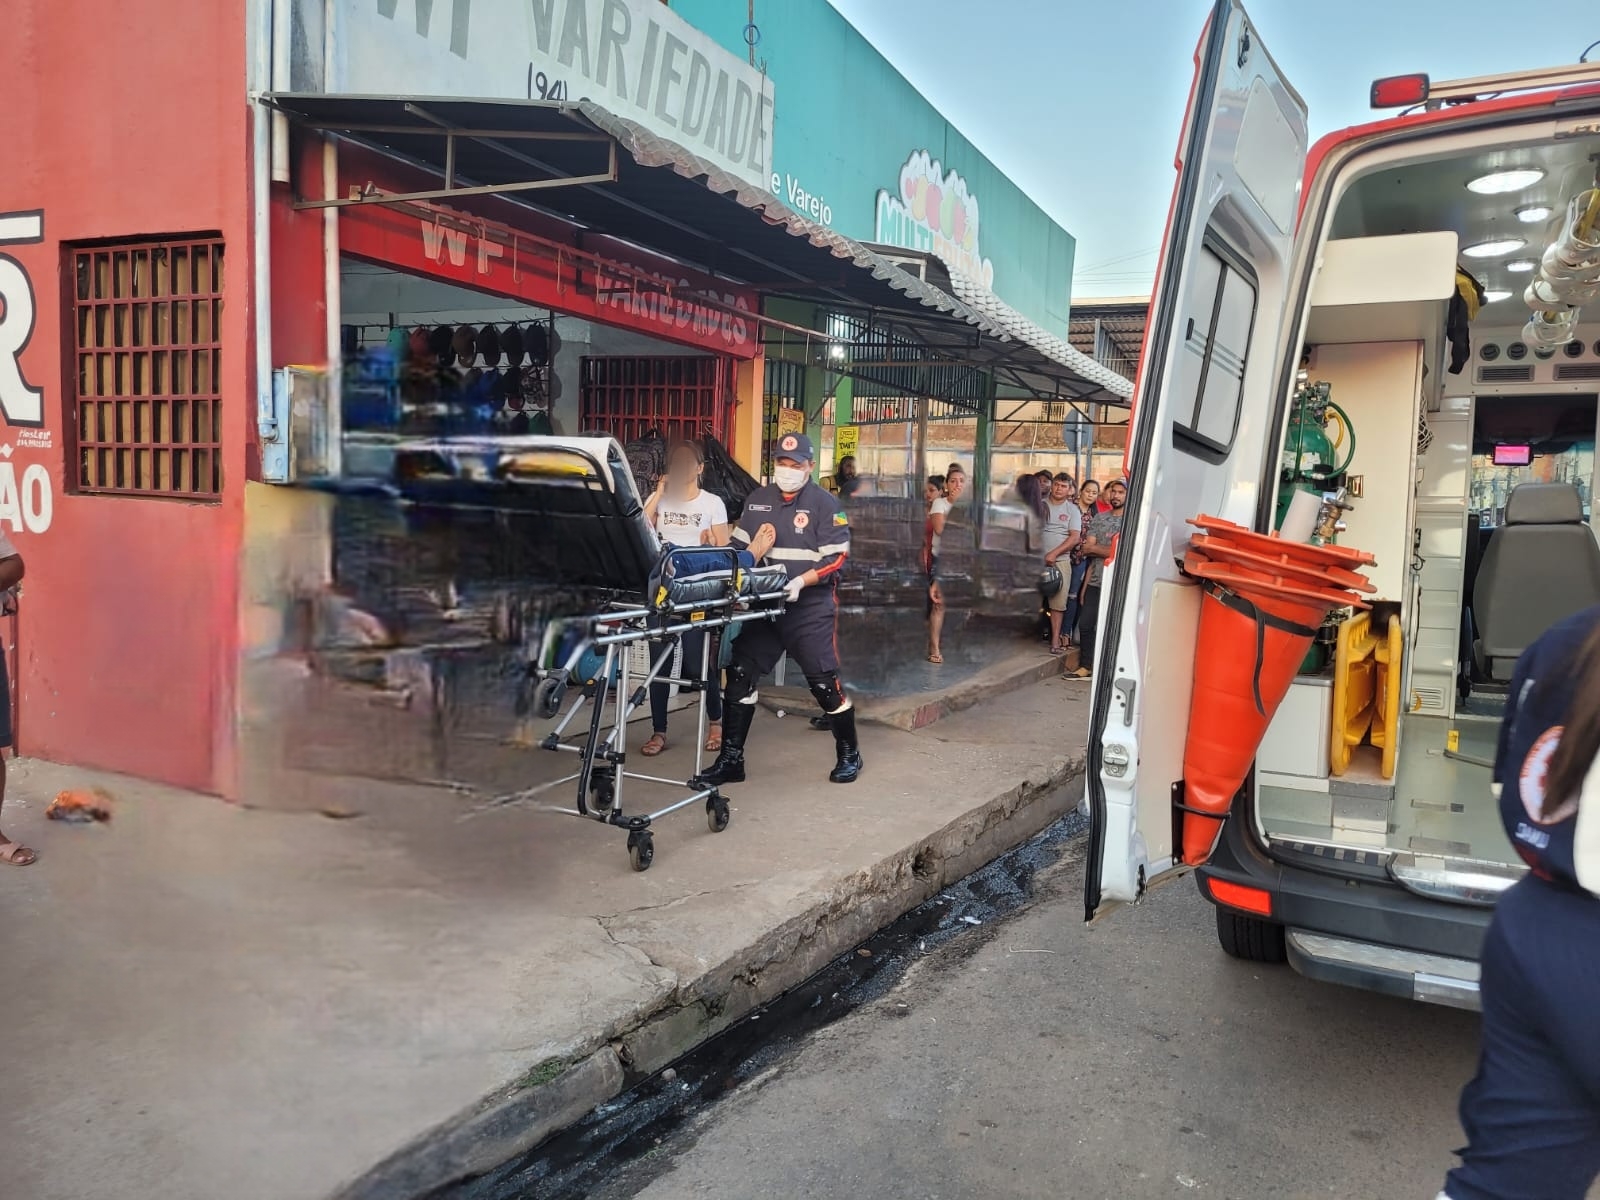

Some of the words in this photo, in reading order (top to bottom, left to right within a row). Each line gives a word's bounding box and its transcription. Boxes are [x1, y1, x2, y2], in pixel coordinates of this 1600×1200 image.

[770, 171, 781, 194] e
[786, 173, 832, 225] Varejo
[421, 201, 503, 274] WF
